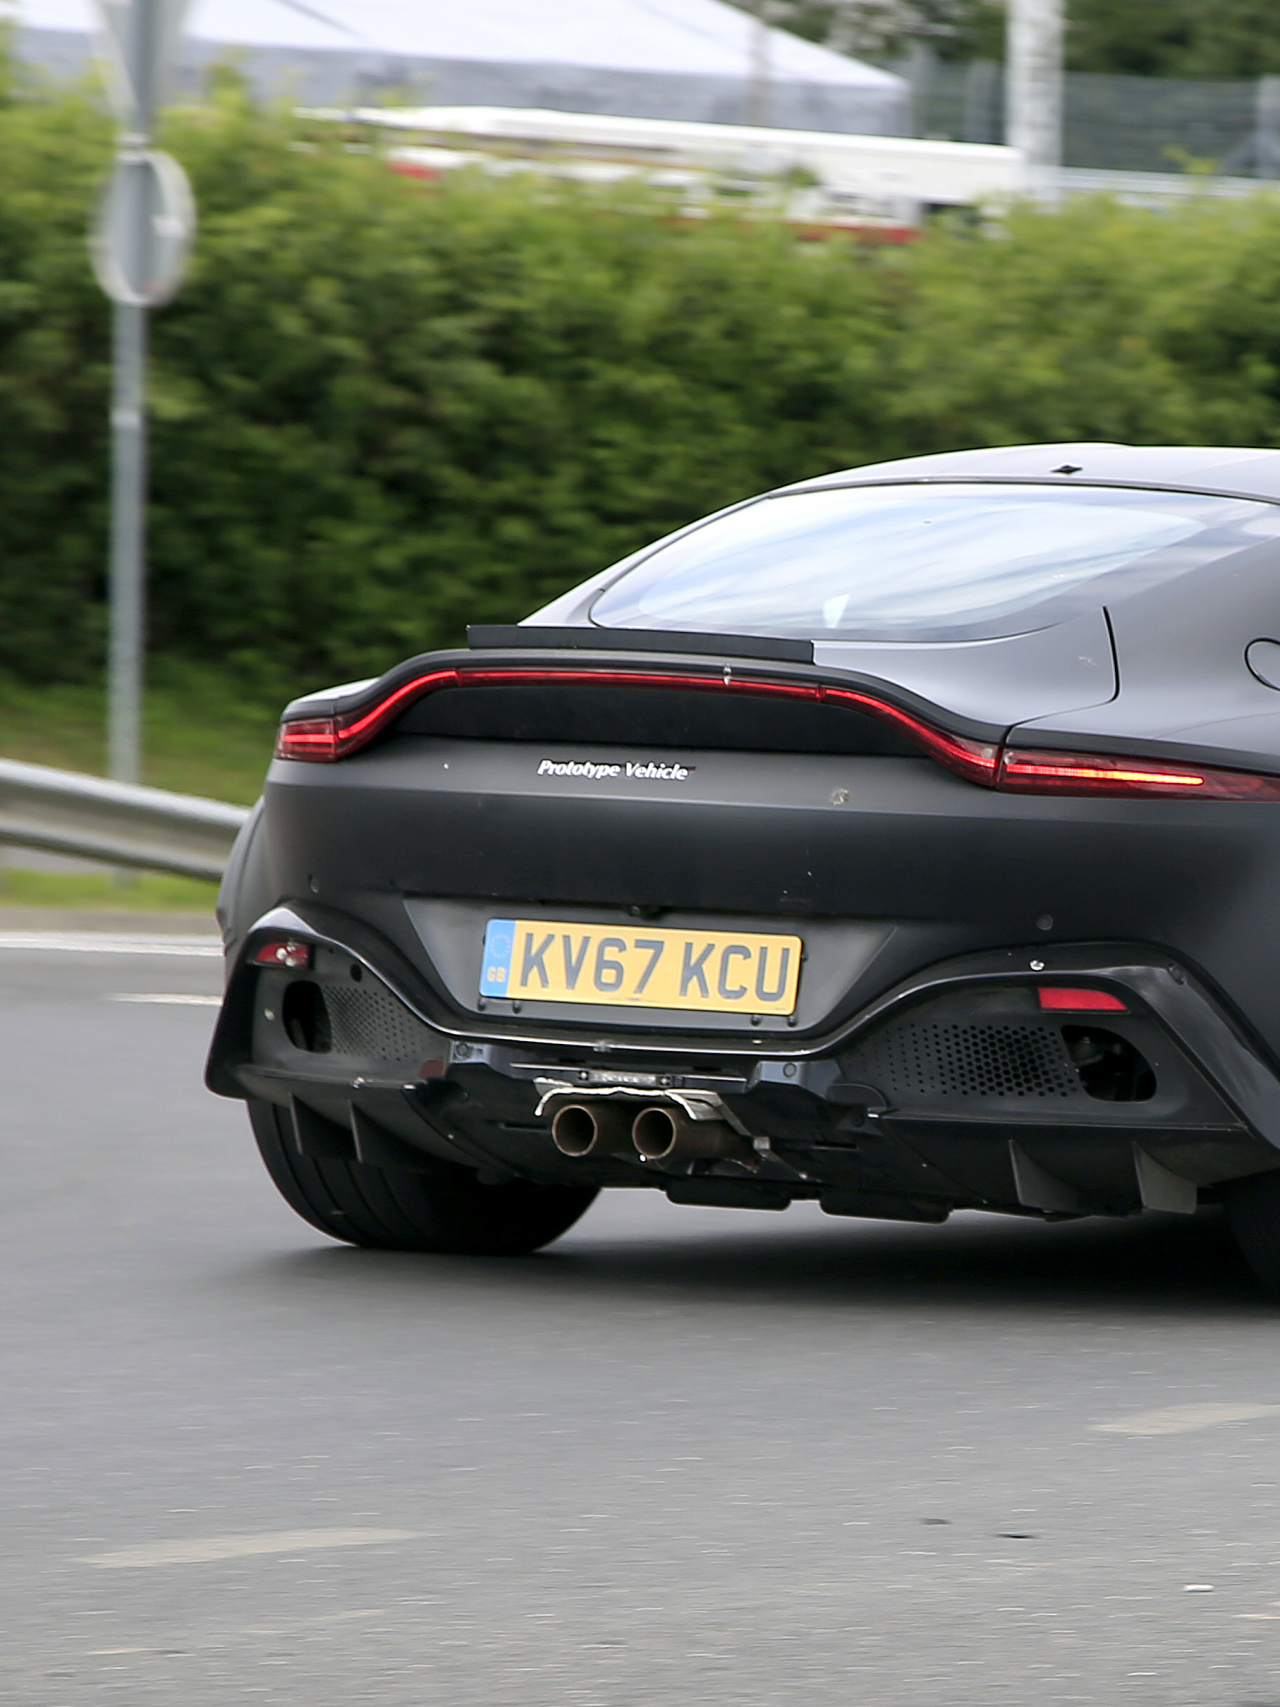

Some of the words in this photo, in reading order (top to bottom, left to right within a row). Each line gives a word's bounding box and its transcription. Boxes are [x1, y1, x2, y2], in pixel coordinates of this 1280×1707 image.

[536, 759, 621, 779] Prototype
[625, 761, 689, 780] Vehicle
[487, 966, 507, 983] GB
[520, 932, 665, 994] KV67
[679, 942, 790, 1002] KCU
